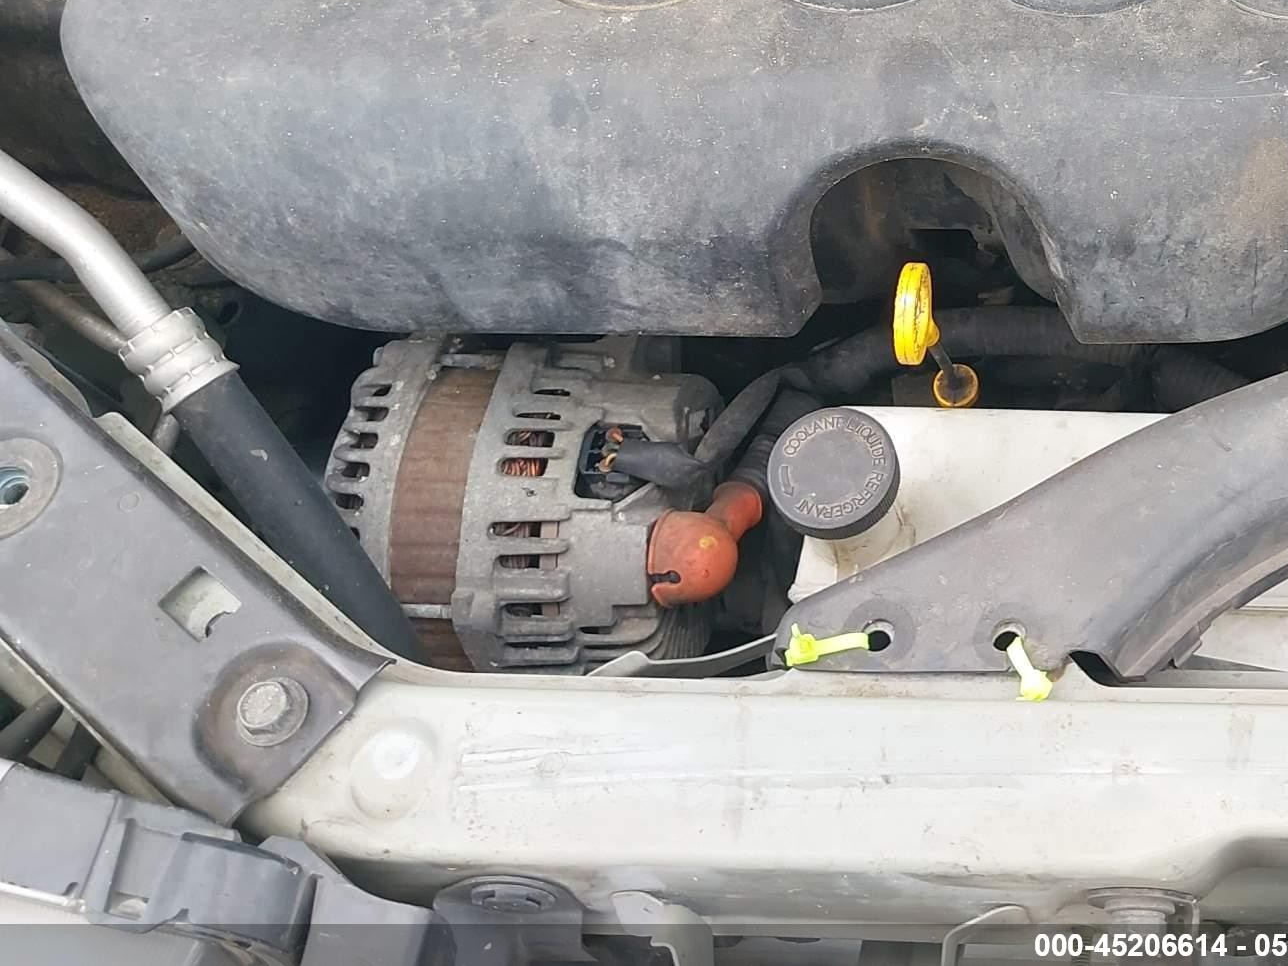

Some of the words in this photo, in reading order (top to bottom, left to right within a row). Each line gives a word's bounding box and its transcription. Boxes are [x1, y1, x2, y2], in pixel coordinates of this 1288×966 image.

[784, 416, 842, 456] COOLANT
[846, 417, 886, 467] LIQUIDE
[795, 471, 885, 519] REFRIGERANT
